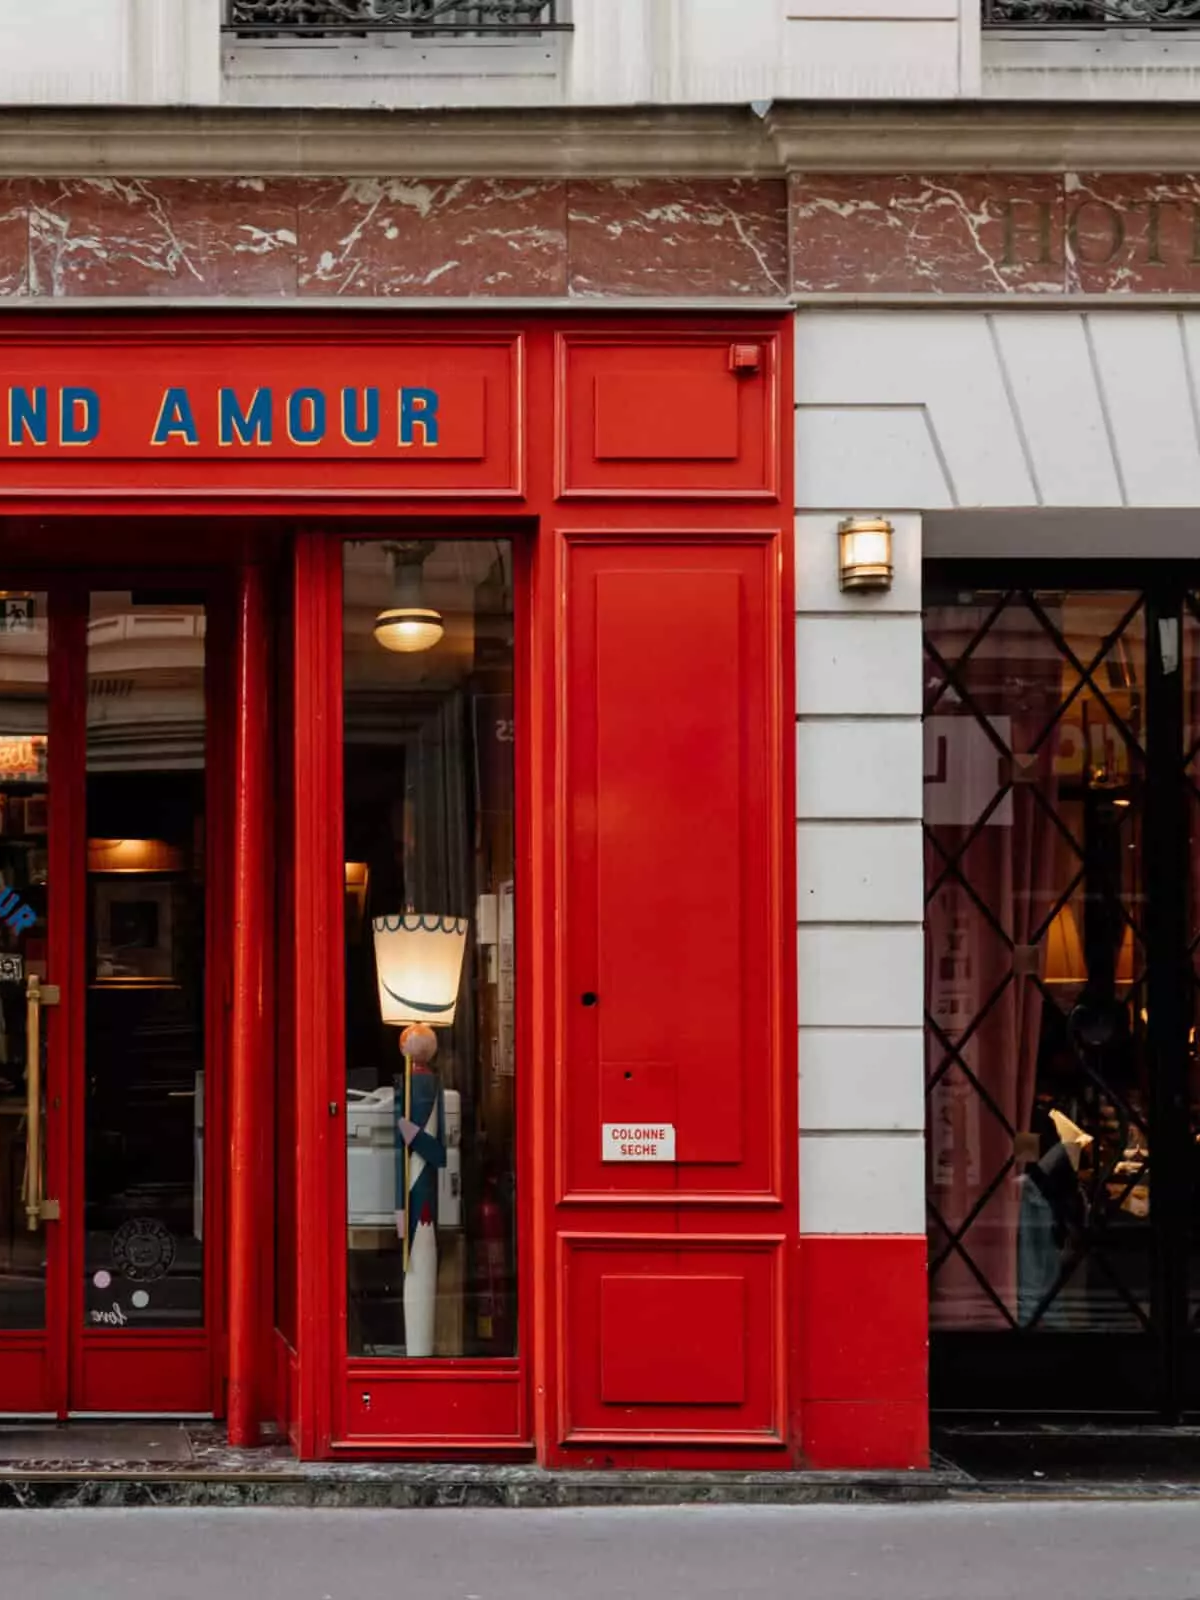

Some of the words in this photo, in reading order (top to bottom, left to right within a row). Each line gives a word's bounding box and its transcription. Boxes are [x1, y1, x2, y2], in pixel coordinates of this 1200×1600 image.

[1001, 199, 1200, 267] HOT
[150, 386, 440, 447] AMOUR
[611, 1128, 665, 1140] COLONNE
[620, 1144, 657, 1156] SECHE
